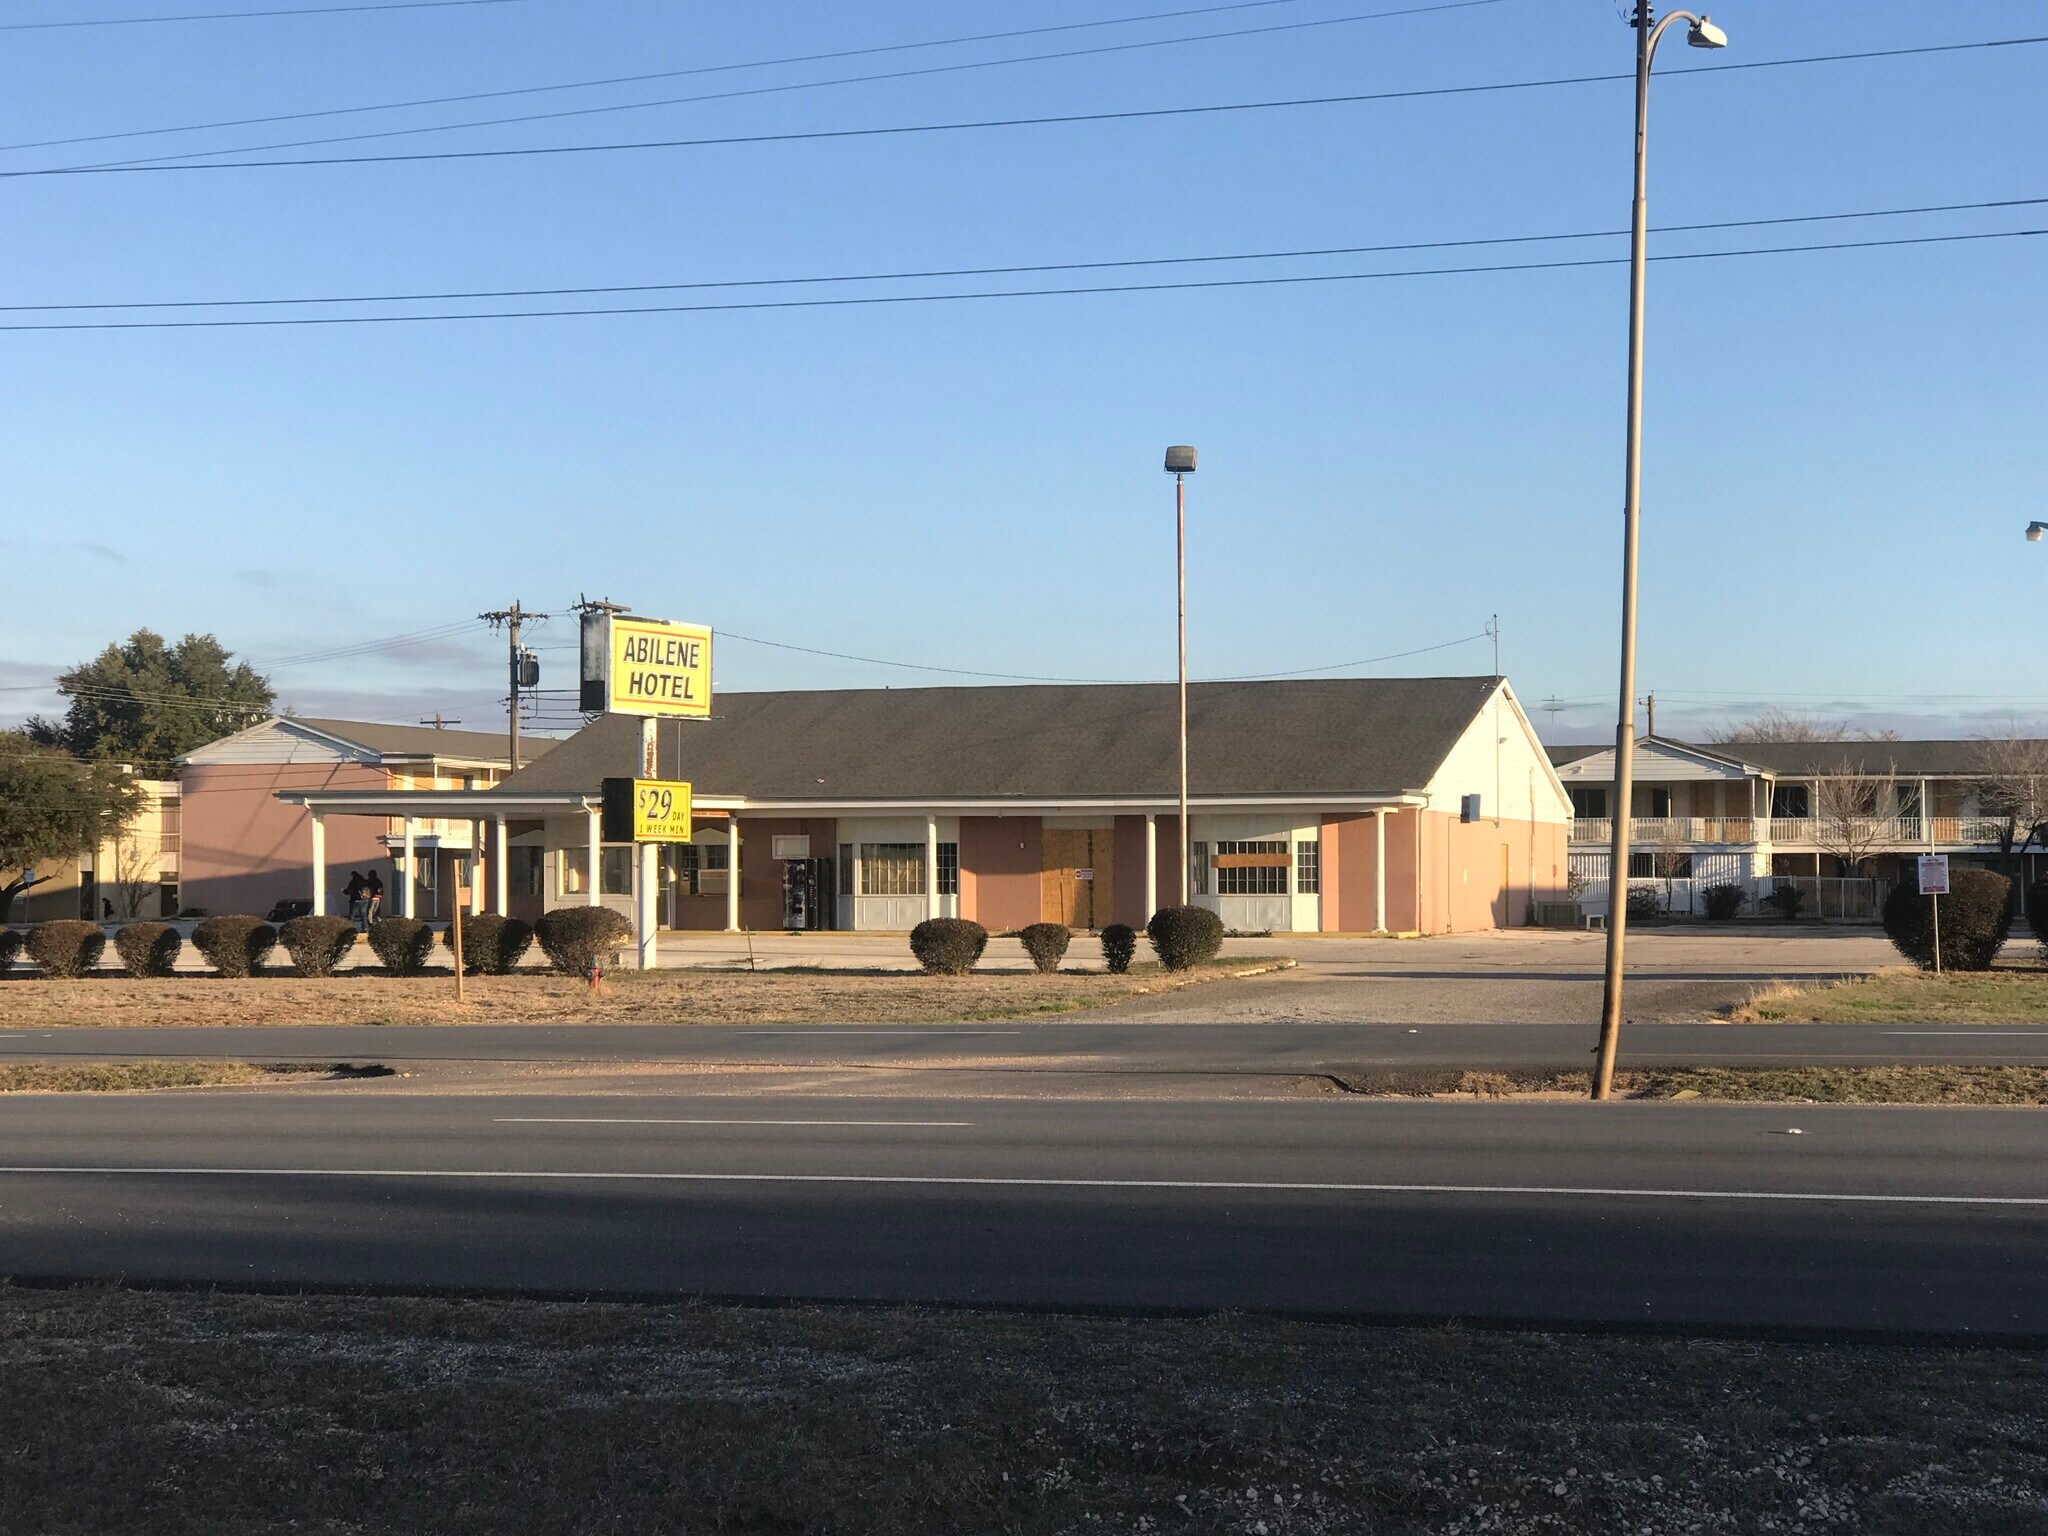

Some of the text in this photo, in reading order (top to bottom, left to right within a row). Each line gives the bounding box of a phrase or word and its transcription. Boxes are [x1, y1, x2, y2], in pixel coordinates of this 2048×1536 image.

[623, 635, 699, 669] ABILENE
[629, 671, 693, 700] HOTEL
[639, 788, 685, 821] $29 DAY
[639, 825, 684, 834] 1 WEEK MIN
